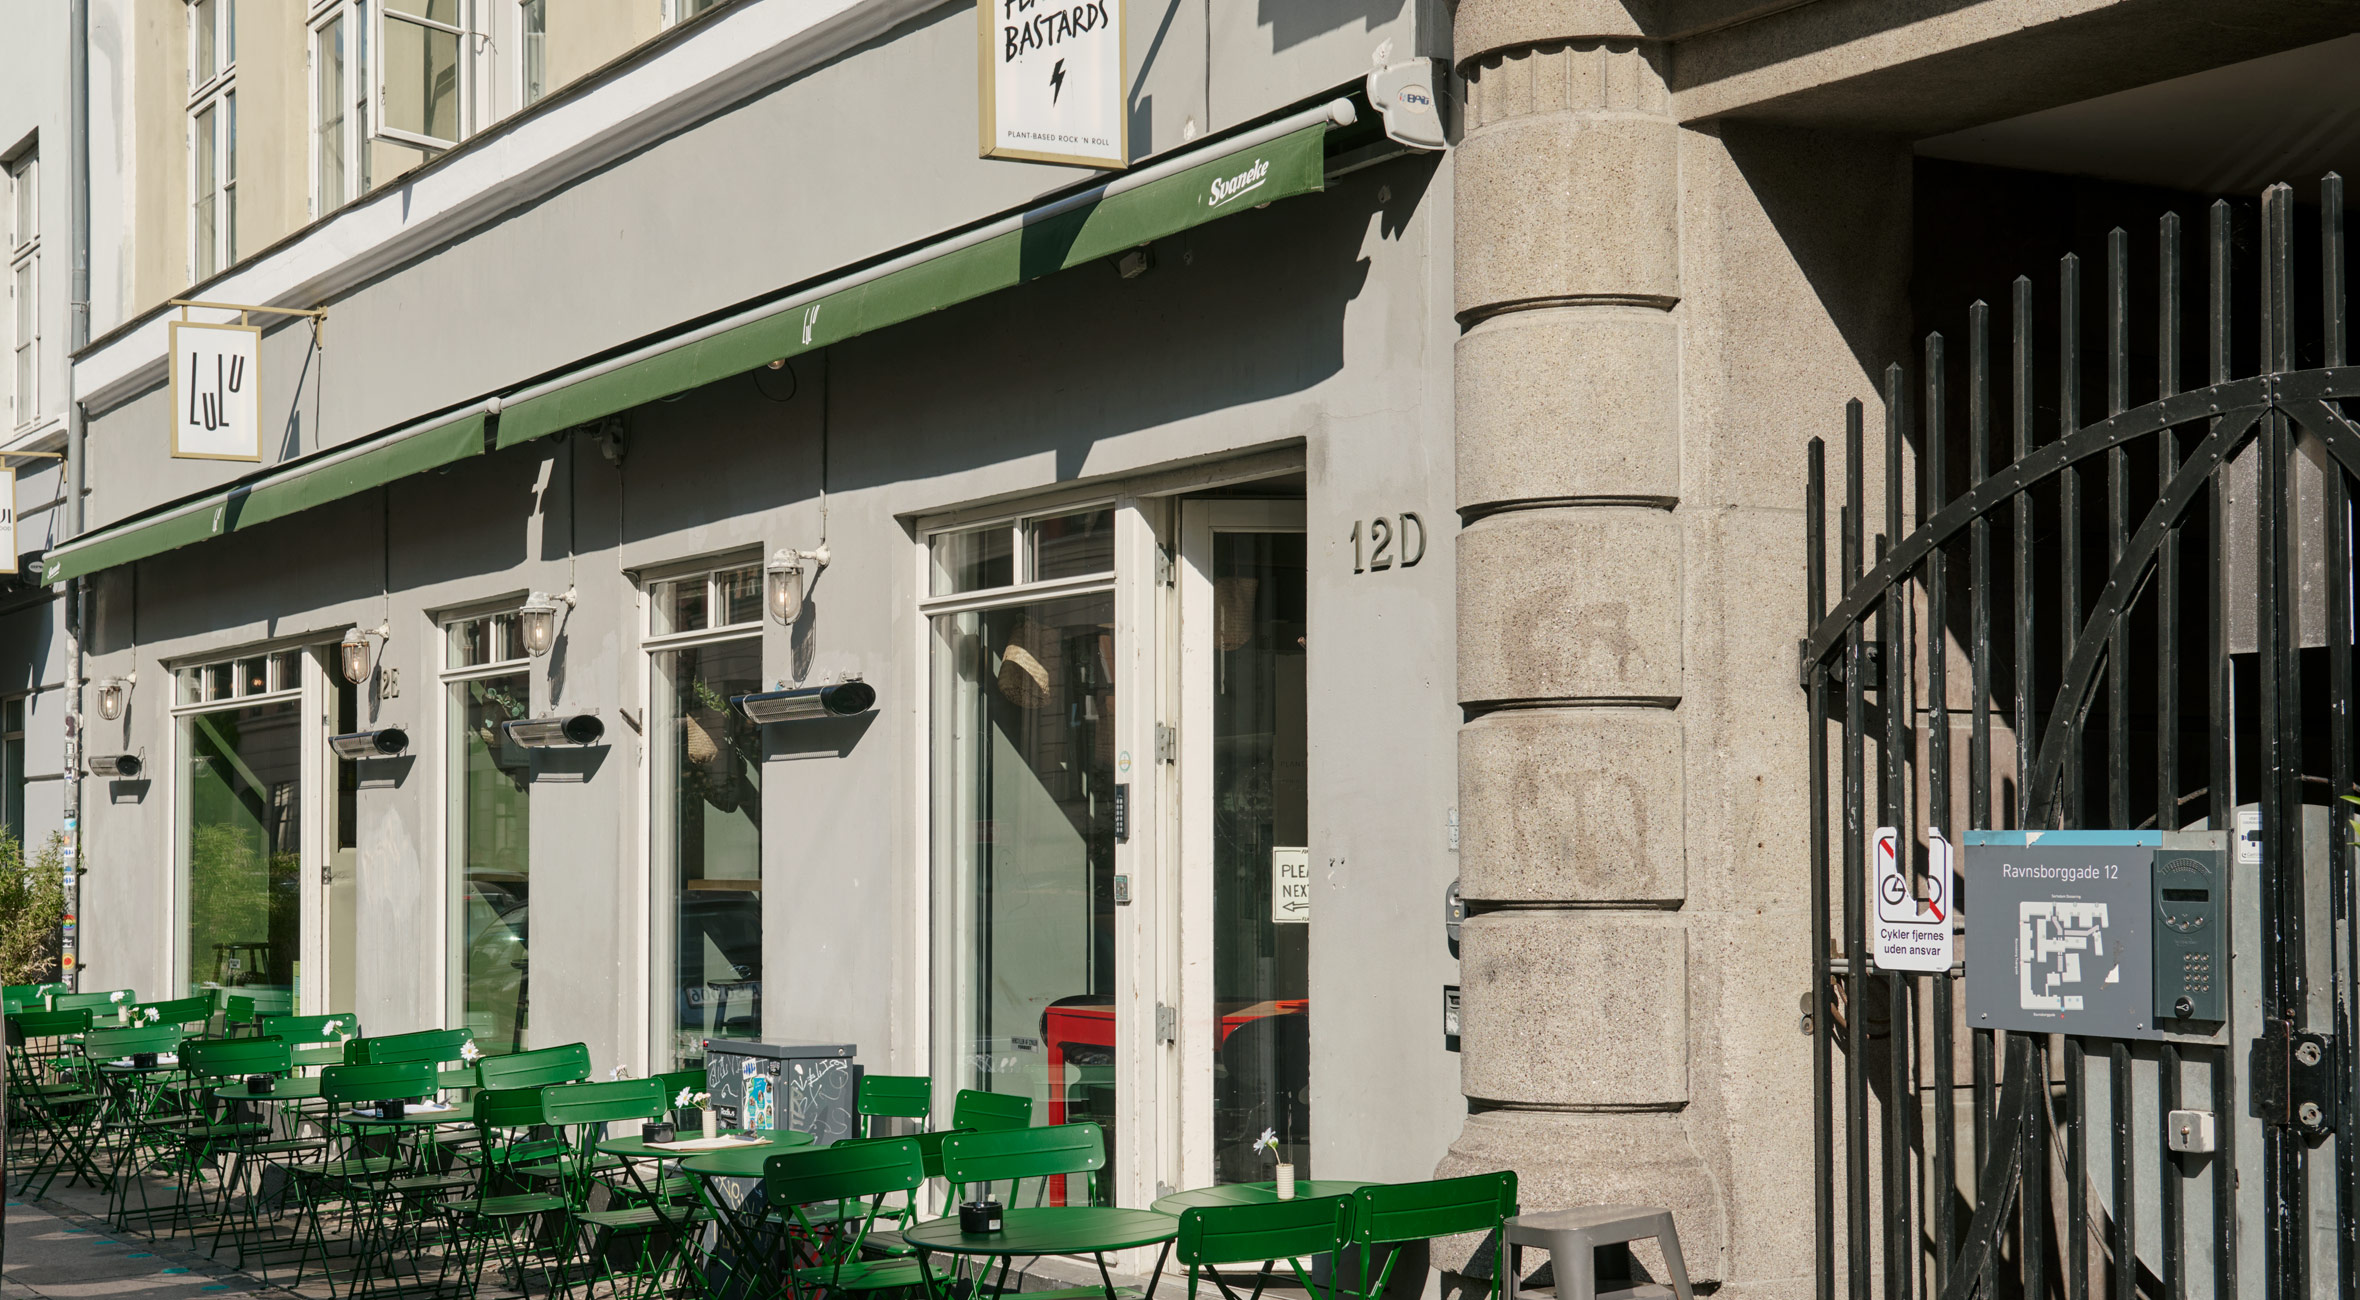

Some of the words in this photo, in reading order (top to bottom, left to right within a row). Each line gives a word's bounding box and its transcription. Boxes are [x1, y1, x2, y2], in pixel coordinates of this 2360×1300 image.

[1004, 0, 1108, 63] BASTARDS
[1007, 130, 1055, 141] PLANT-BASED
[1058, 135, 1078, 143] ROCK
[1091, 138, 1109, 146] ROLL
[1208, 158, 1270, 206] Svaneke
[1350, 511, 1427, 575] 12D
[1281, 864, 1309, 878] PLE
[2002, 863, 2100, 882] Ravnsborggade
[2104, 864, 2119, 880] 12
[1282, 884, 1309, 898] NEX
[1880, 928, 1910, 942] Cykler
[1912, 929, 1944, 943] fjernes
[1884, 944, 1907, 954] uden
[1909, 946, 1941, 956] ansvar
